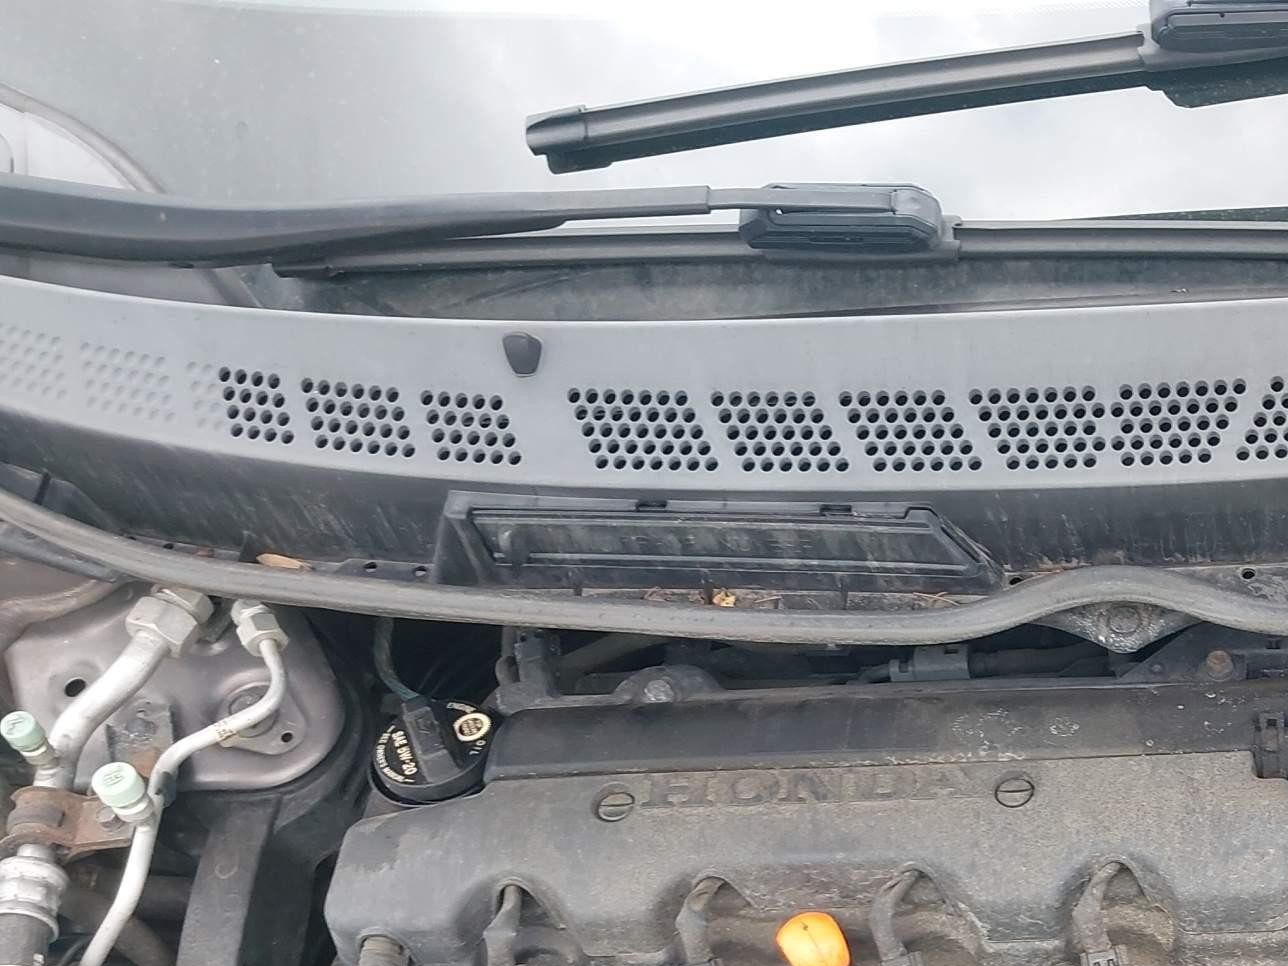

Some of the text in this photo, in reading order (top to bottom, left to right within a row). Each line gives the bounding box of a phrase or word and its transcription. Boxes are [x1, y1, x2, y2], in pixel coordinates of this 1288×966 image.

[391, 730, 418, 776] SAE 5W-20
[640, 767, 986, 809] HONDA
